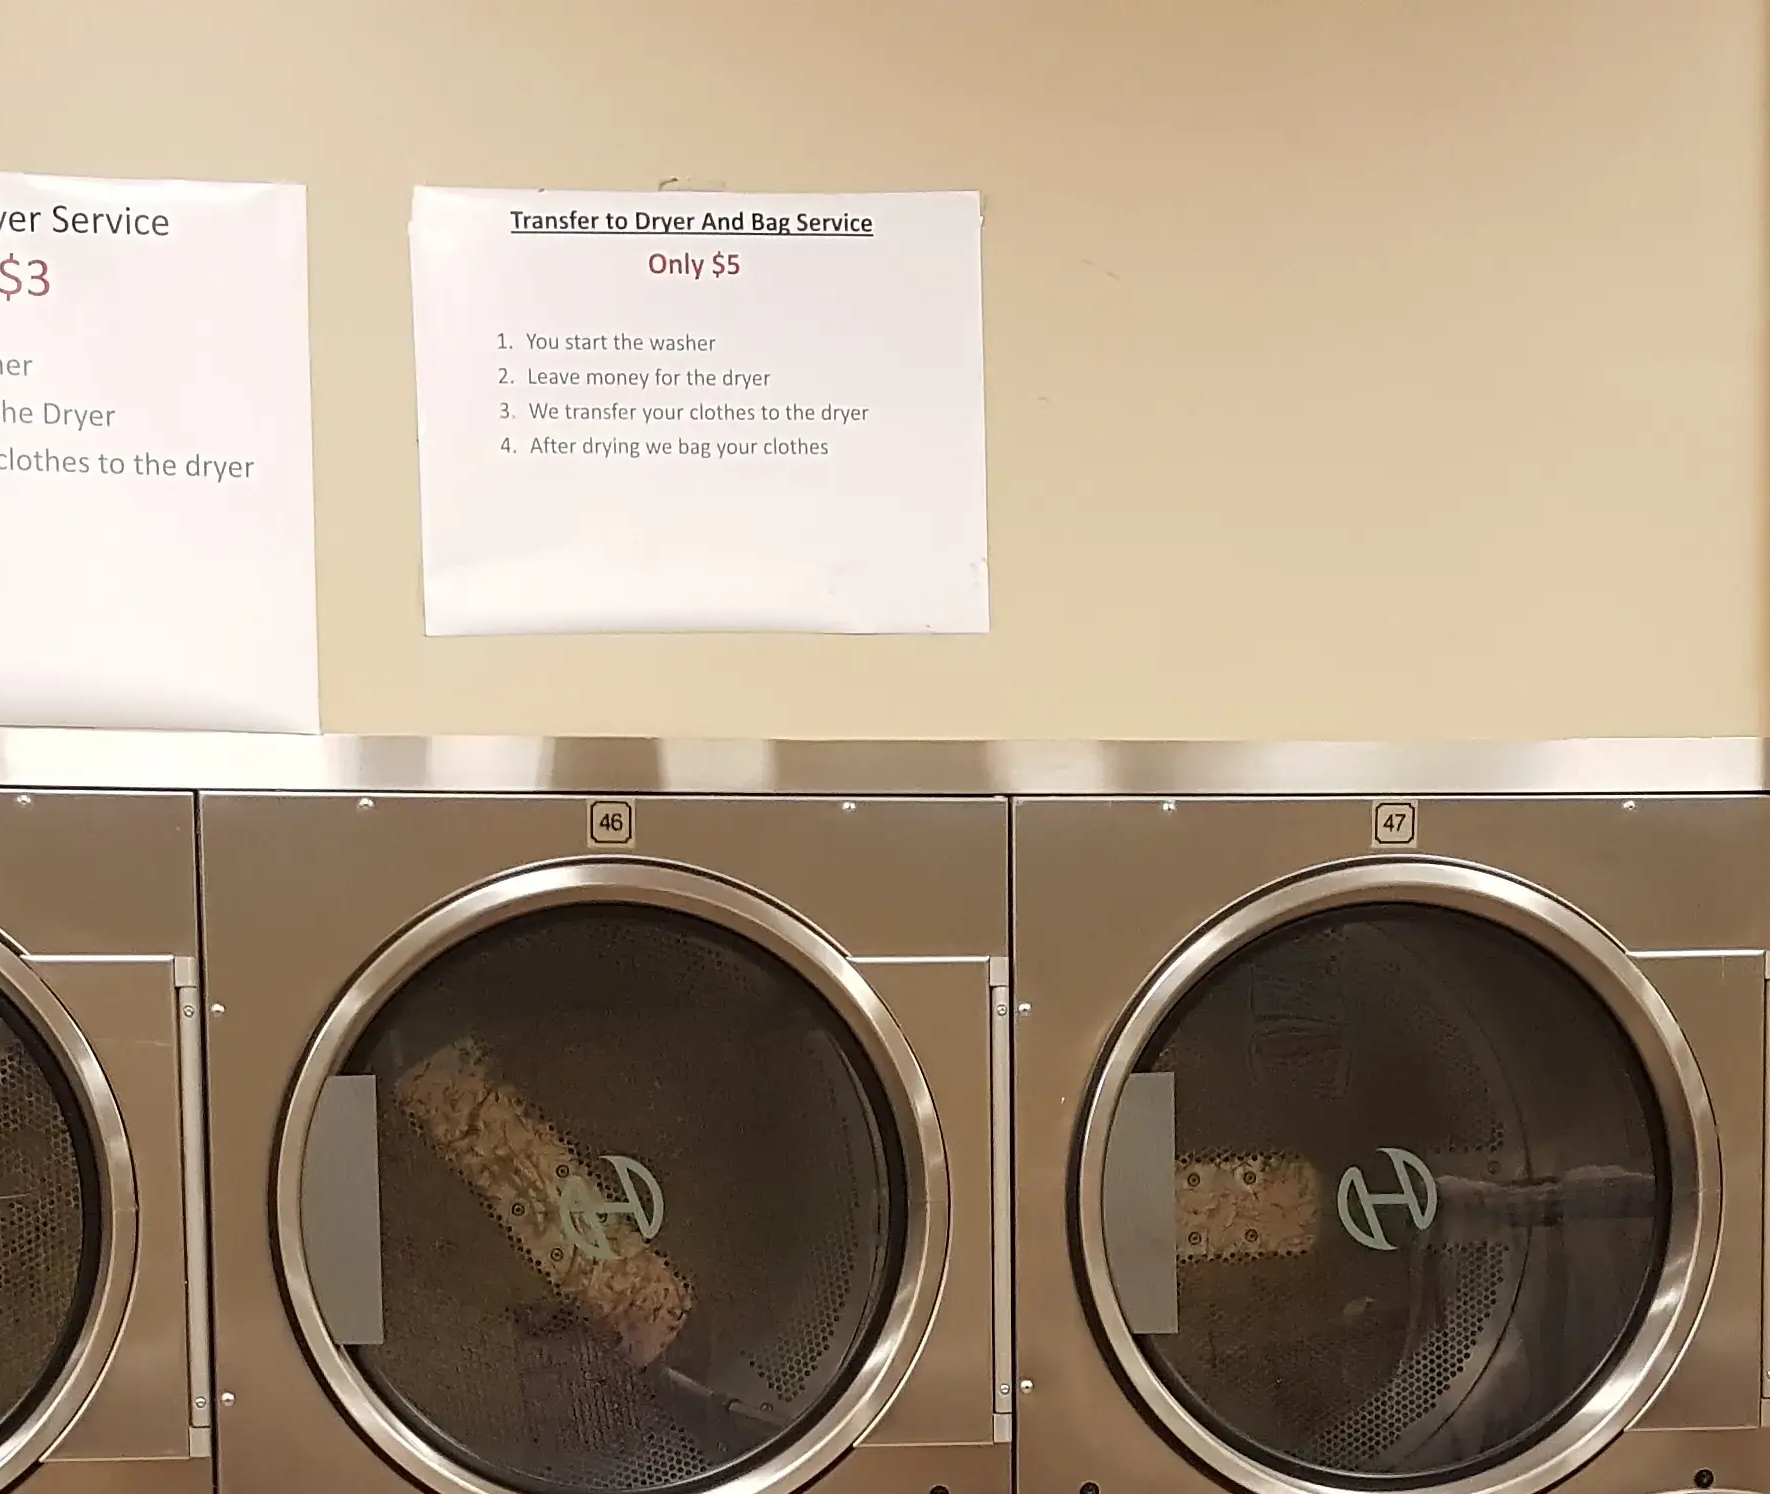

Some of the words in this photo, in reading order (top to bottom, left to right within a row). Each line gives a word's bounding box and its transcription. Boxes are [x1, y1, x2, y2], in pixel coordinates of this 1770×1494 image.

[53, 205, 168, 236] Service
[510, 210, 599, 229] Transfer
[606, 213, 627, 229] to
[634, 212, 695, 235] Dryer
[702, 211, 743, 230] And
[751, 213, 791, 236] Bag
[797, 213, 872, 232] Service
[0, 253, 49, 301] $3
[649, 253, 704, 280] Only
[713, 251, 739, 278] $5
[44, 403, 115, 431] Dryer
[501, 437, 516, 453] 4.
[530, 436, 576, 454] After
[583, 437, 639, 458] drying
[646, 442, 672, 454] we
[679, 437, 710, 458] bag
[717, 442, 757, 459] your
[764, 438, 828, 454] clothes
[599, 813, 623, 831] 46
[1383, 814, 1406, 832] 47
